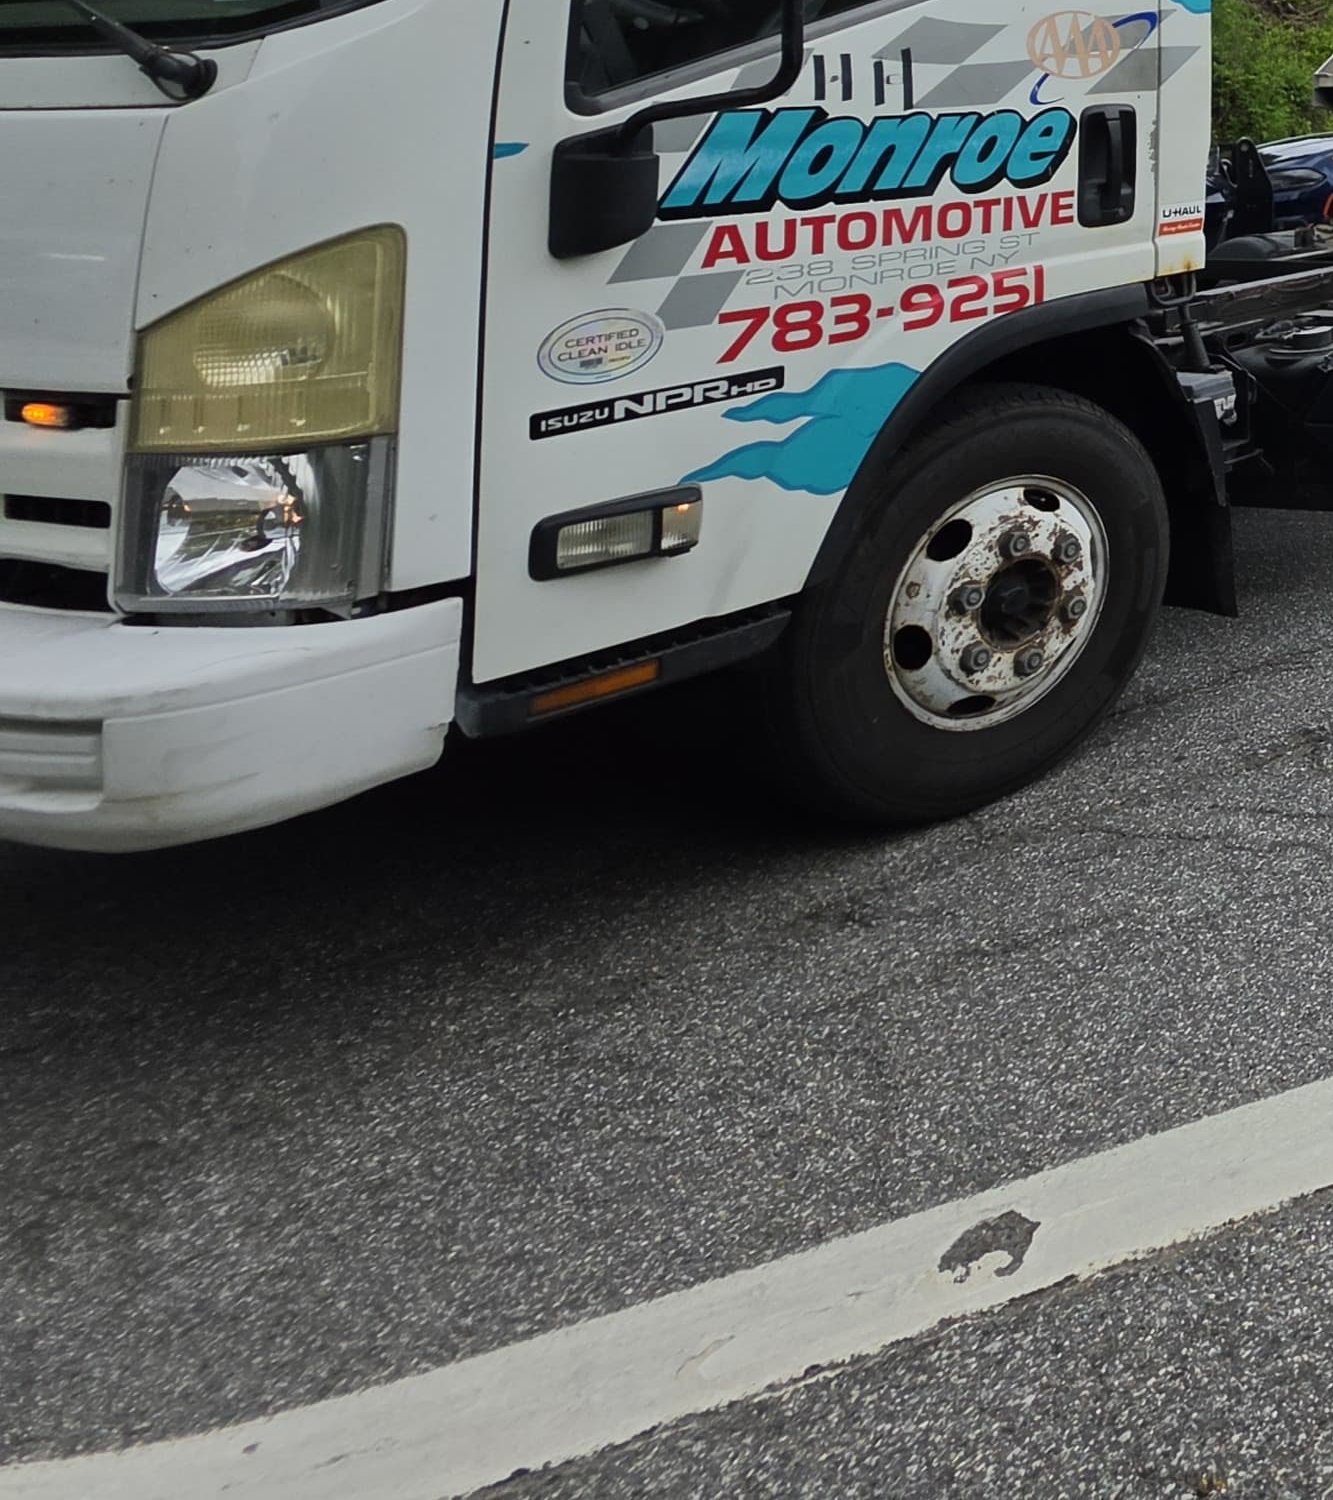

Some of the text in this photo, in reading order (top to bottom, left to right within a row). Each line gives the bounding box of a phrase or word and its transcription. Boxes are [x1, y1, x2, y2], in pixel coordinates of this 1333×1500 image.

[1030, 11, 1118, 78] AAA
[656, 104, 1078, 220] Monroe
[701, 190, 1075, 269] AUTOMOTIVE
[745, 231, 1041, 285] 238 SPRING ST
[774, 250, 1021, 300] MONROE NY
[564, 328, 640, 349] CERTIFIED
[716, 264, 1045, 364] 783-9251
[557, 338, 647, 362] CLEAN IDLE
[540, 377, 777, 431] ISUZU NPR HD
